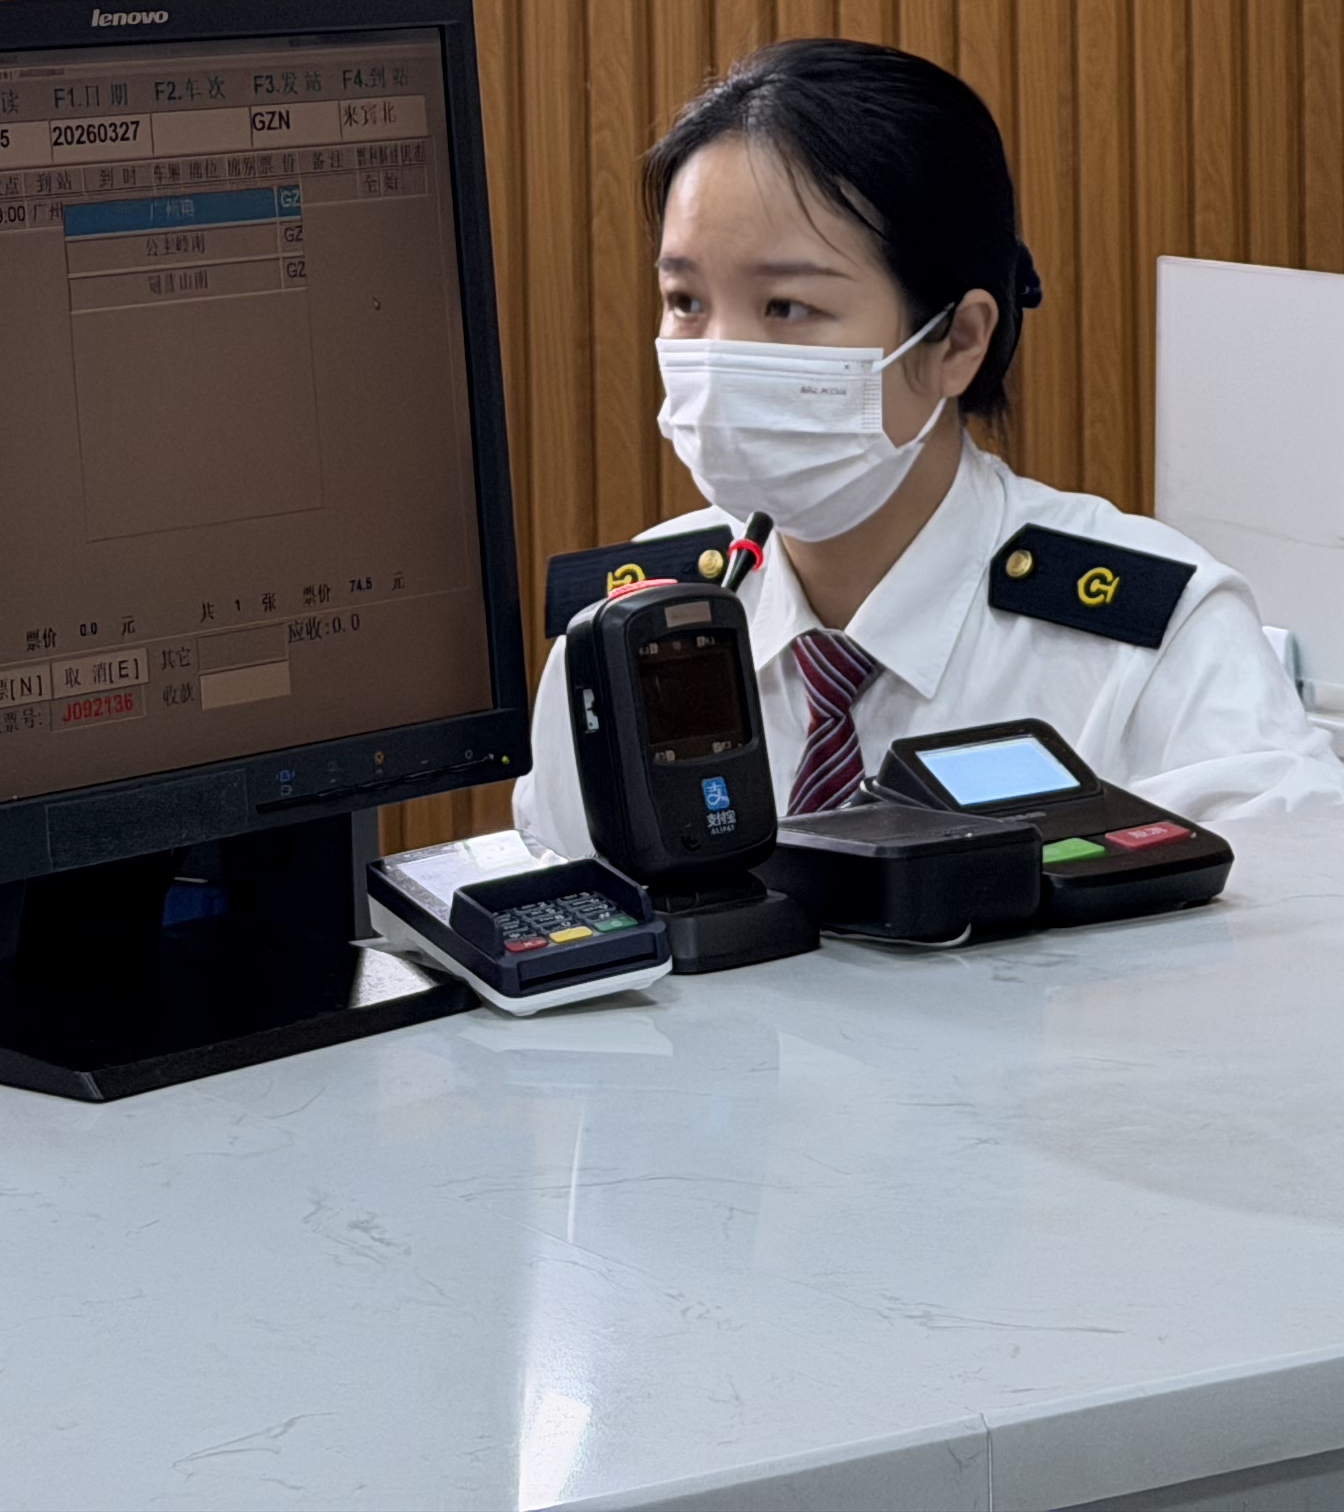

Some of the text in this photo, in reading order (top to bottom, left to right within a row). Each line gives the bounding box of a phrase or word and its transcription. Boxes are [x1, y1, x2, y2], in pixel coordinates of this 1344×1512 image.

[91, 8, 169, 27] lenovo
[52, 120, 141, 147] 20260327
[252, 109, 292, 132] GZN
[120, 614, 137, 637] 元
[349, 576, 374, 593] 74.5
[707, 810, 737, 827] 支付宝
